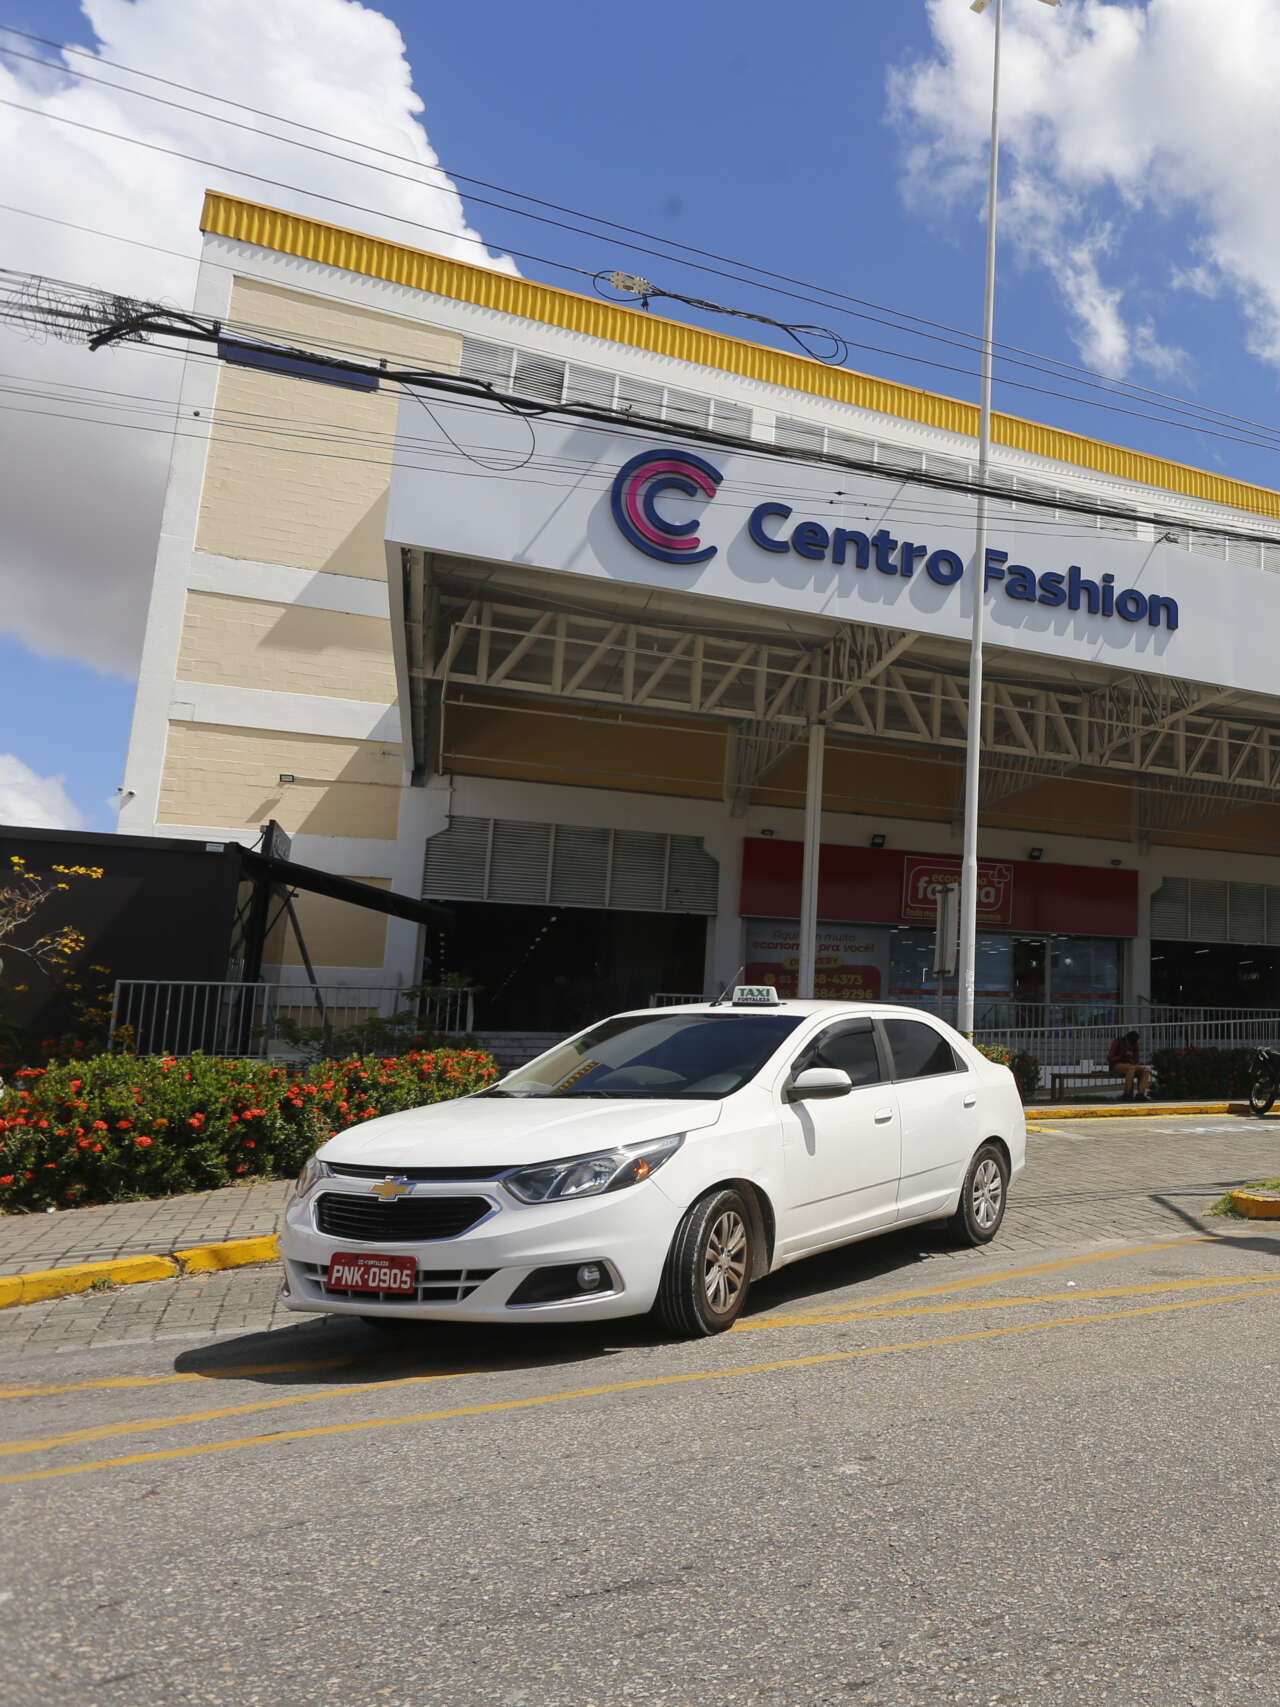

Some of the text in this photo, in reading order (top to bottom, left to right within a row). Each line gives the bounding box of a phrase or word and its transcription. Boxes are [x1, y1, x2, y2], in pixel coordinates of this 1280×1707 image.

[748, 502, 1179, 631] Centro Fashion
[918, 876, 996, 903] faa
[737, 988, 770, 997] TAXI
